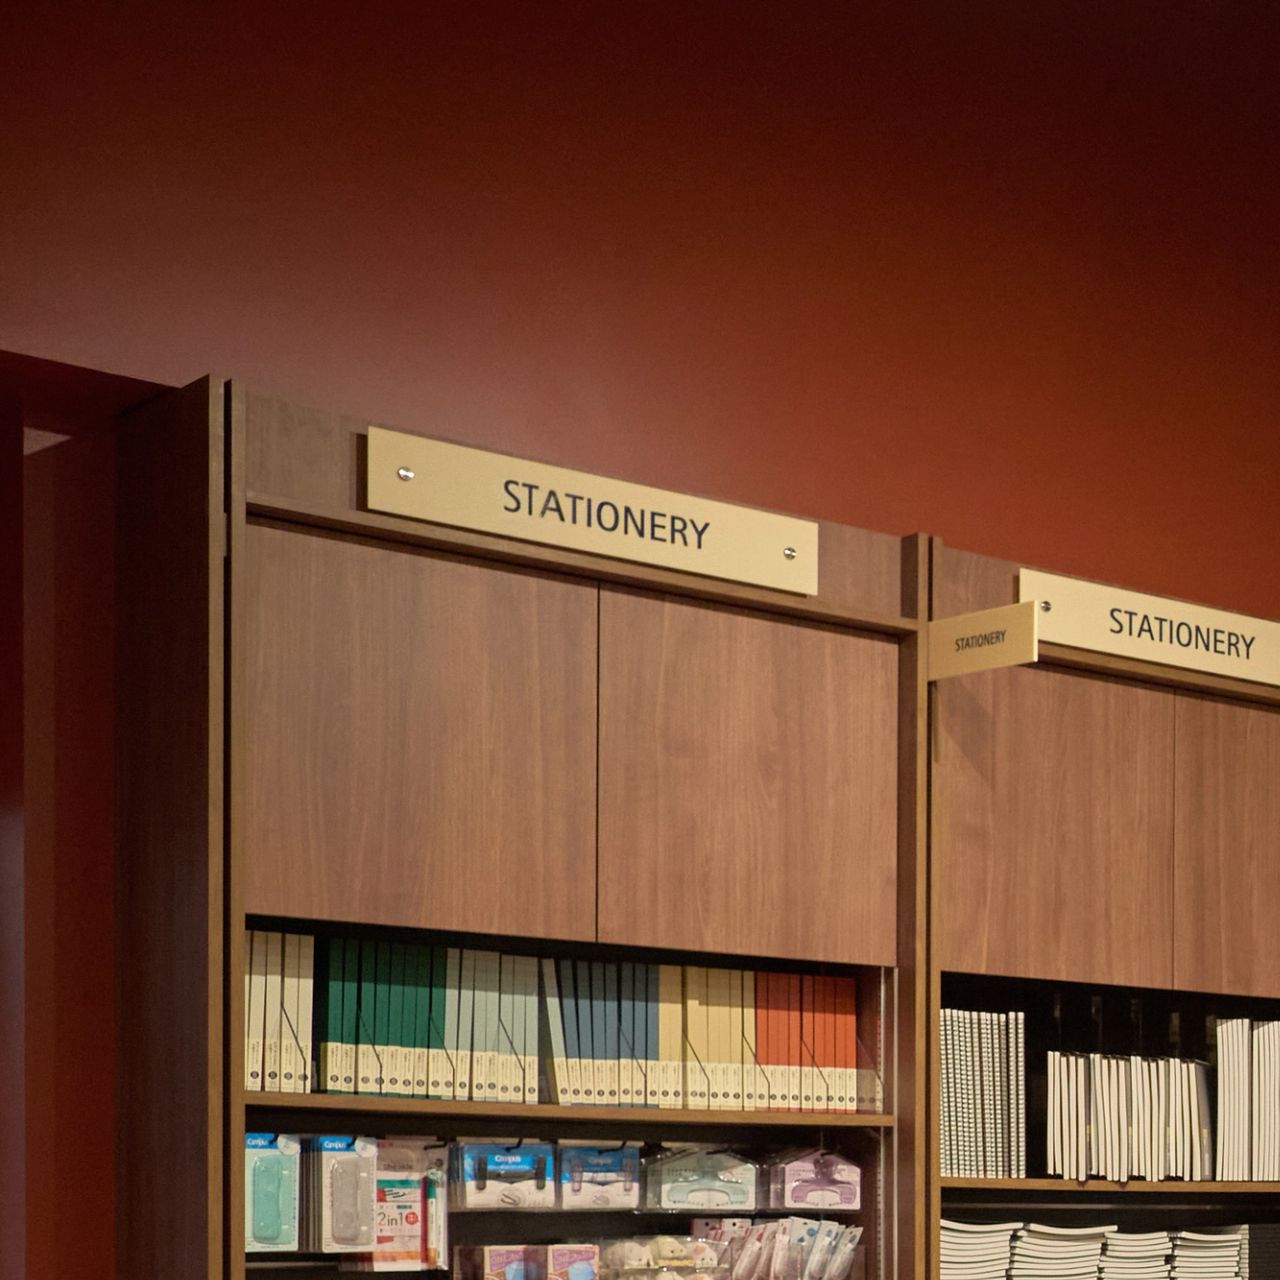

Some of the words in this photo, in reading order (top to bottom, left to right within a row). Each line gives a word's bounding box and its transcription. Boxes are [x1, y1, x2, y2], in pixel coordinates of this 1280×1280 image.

[502, 479, 710, 551] STATIONERY
[955, 628, 1008, 653] STATIONERY
[1108, 607, 1256, 661] STATIONERY
